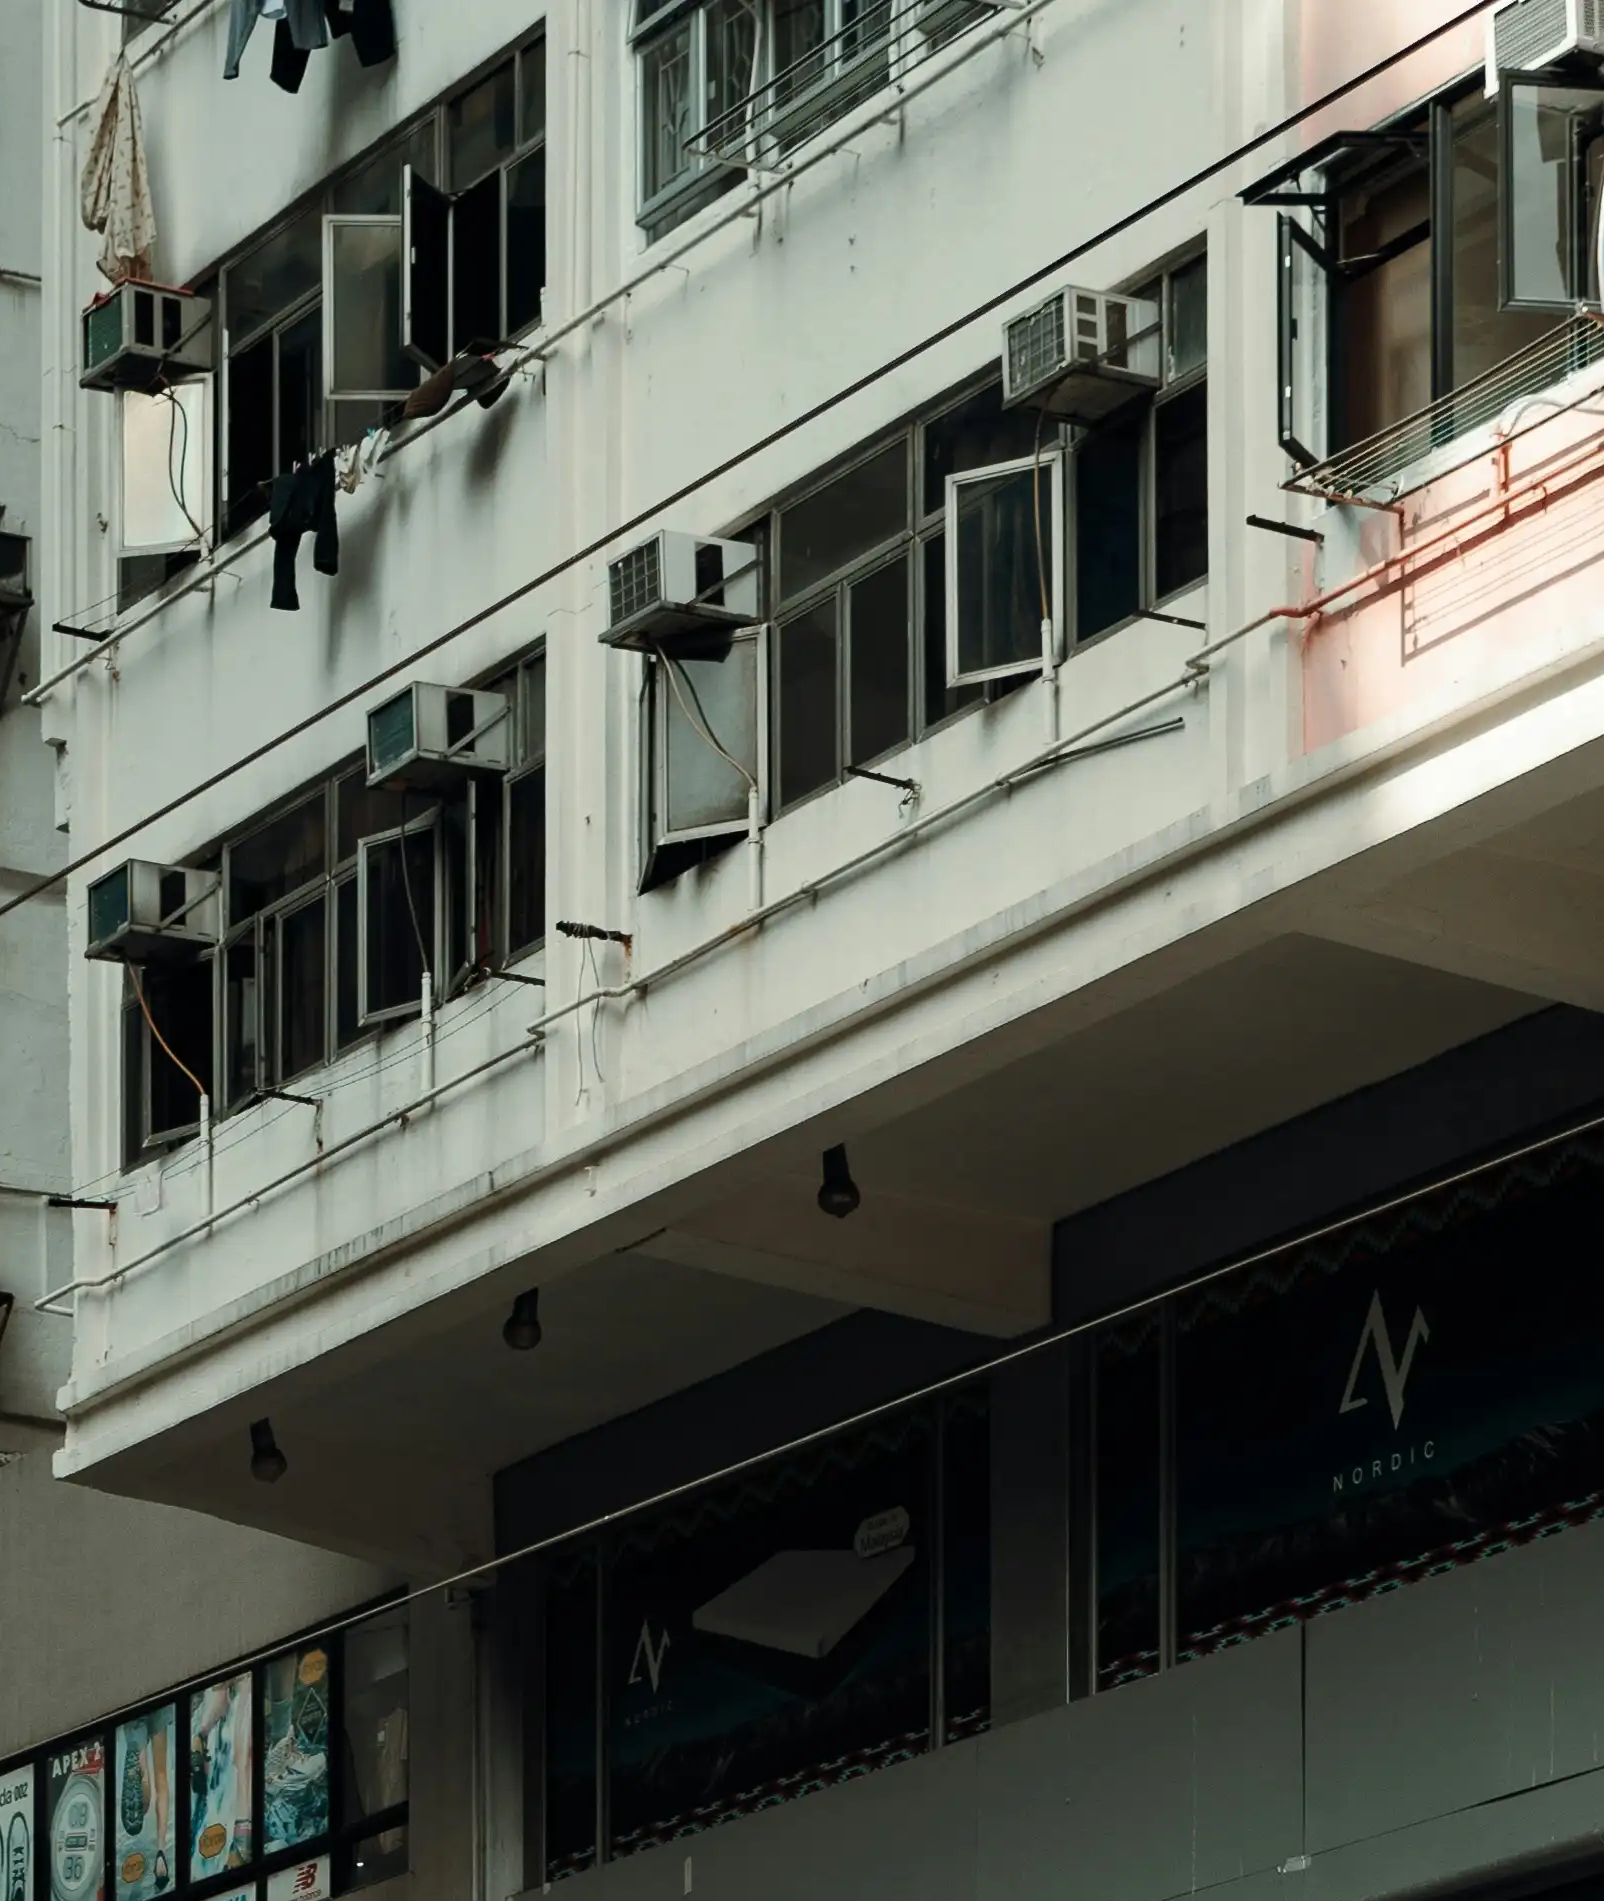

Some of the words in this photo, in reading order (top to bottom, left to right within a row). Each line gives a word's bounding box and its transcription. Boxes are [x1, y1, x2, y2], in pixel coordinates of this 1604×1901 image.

[1333, 1441, 1437, 1493] NORDIC
[51, 1749, 90, 1779] APEX
[13, 1782, 29, 1802] 002
